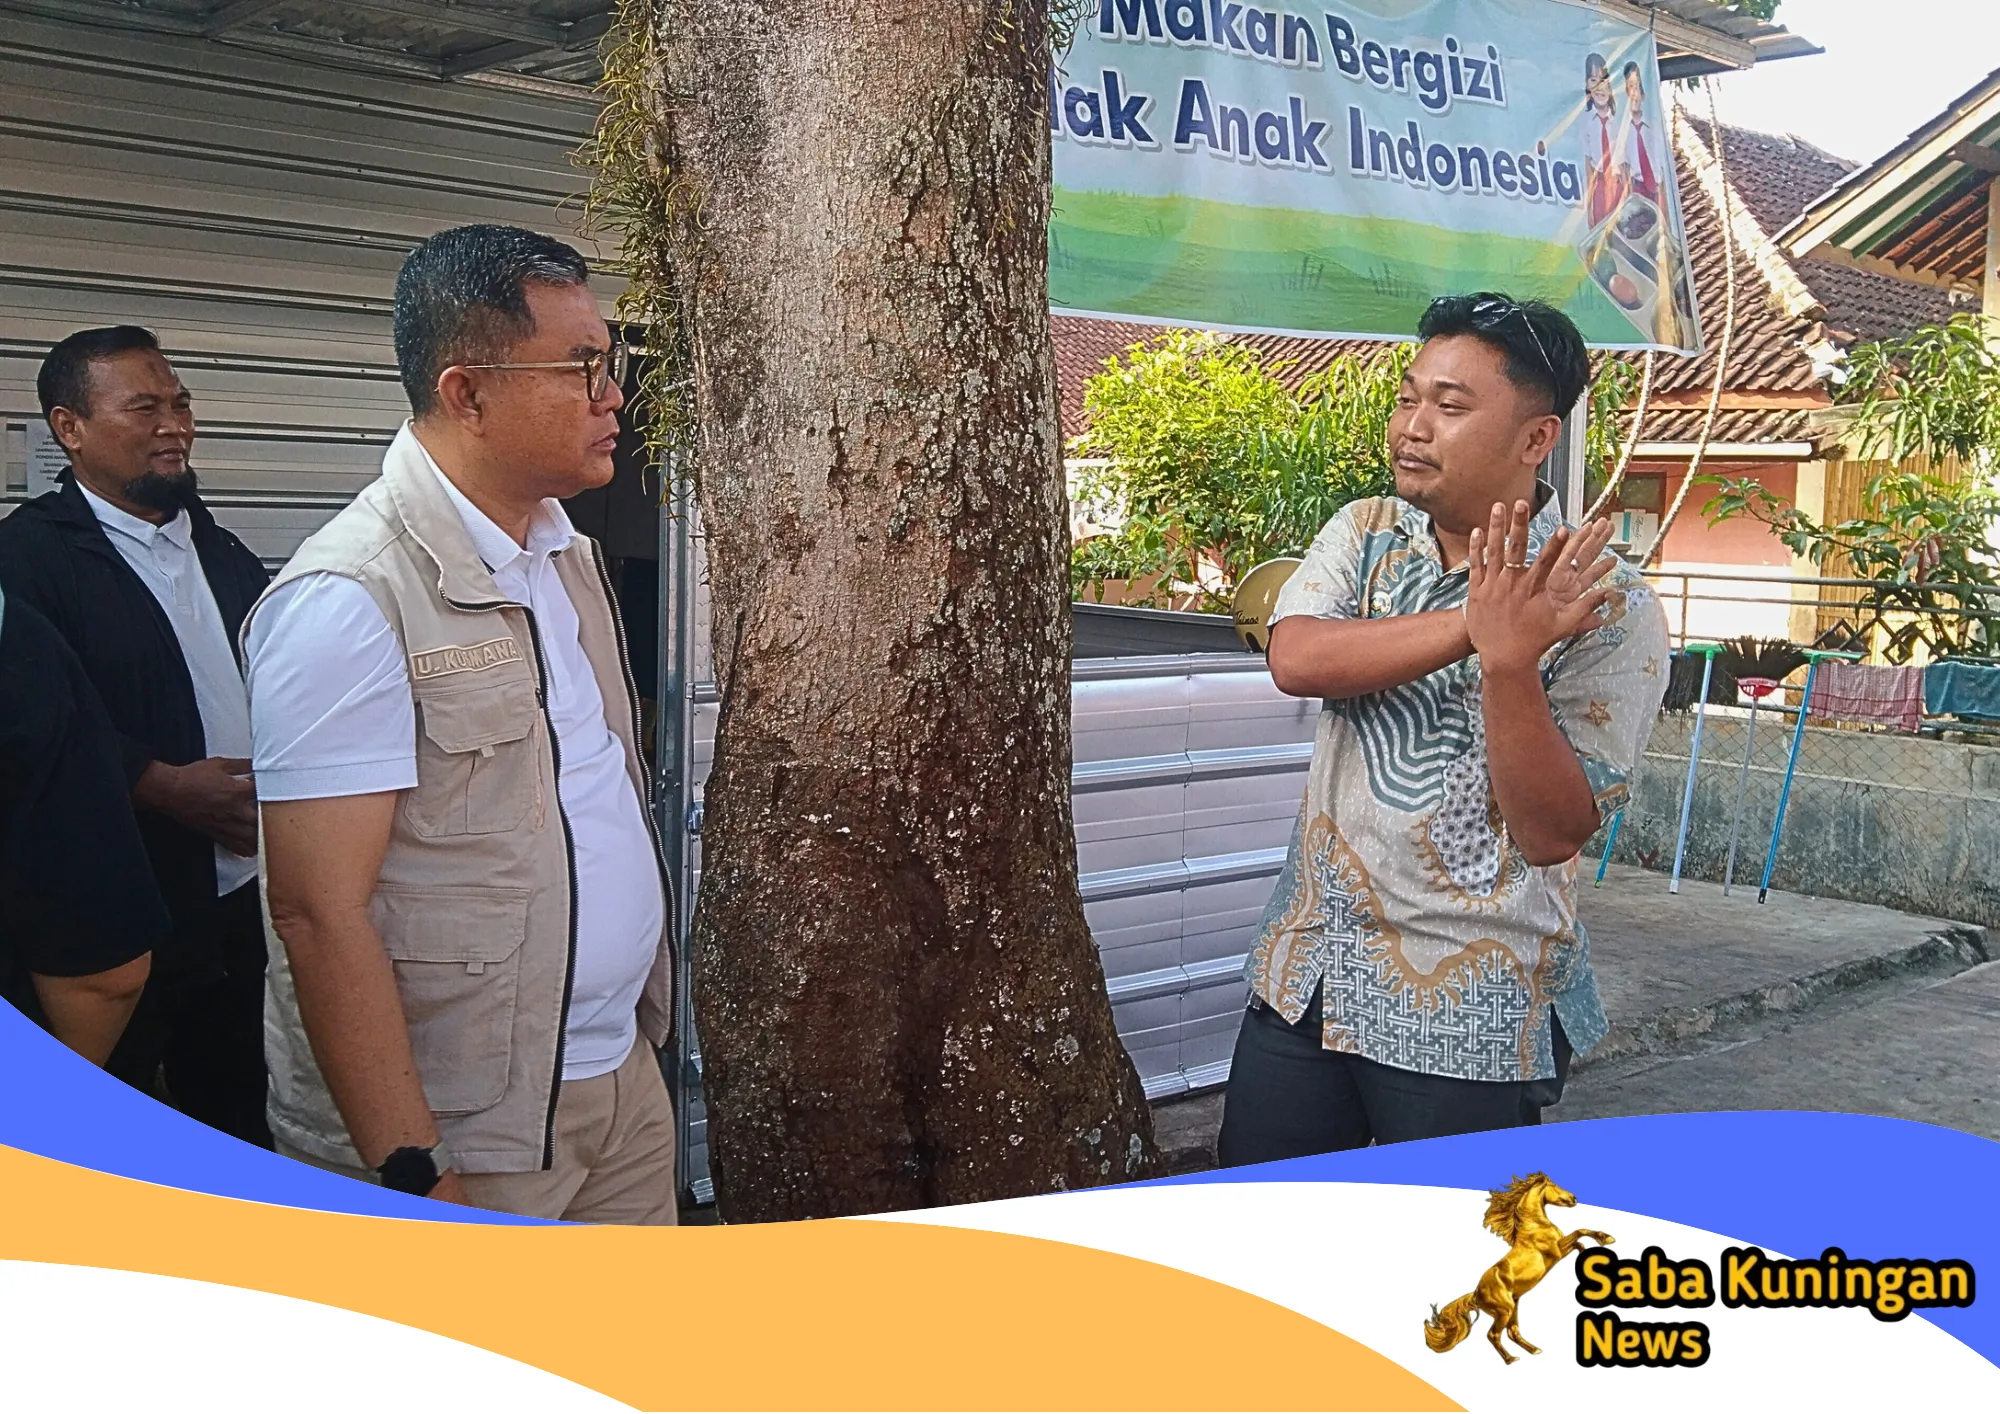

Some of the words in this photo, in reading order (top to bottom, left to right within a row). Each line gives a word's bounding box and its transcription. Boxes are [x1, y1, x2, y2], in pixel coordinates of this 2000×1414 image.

[1100, 0, 1319, 62] Makan
[1325, 13, 1504, 110] Bergizi
[1050, 66, 1154, 143] ak
[1174, 79, 1328, 167] Anak
[1348, 106, 1582, 201] Indonesia
[417, 656, 441, 674] U.
